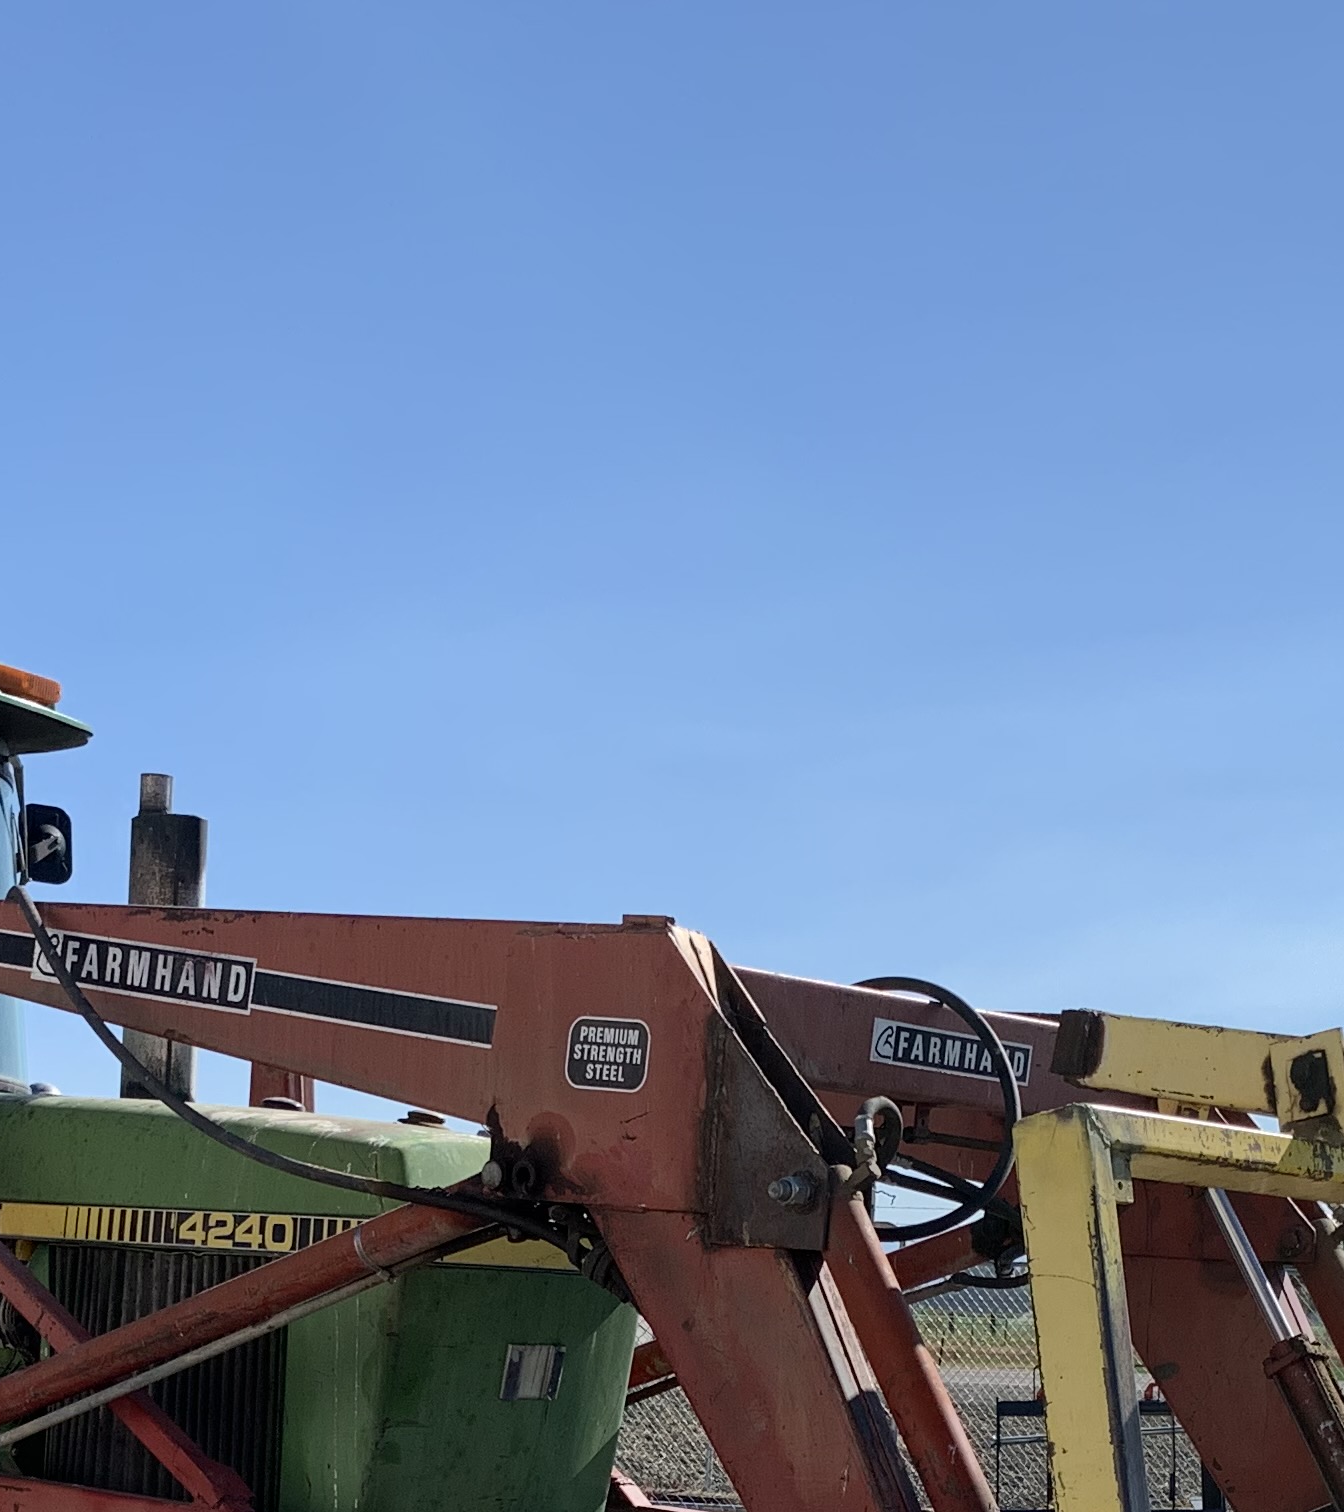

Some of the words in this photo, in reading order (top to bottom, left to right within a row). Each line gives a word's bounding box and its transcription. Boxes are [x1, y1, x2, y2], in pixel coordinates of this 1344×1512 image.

[65, 940, 247, 1003] FARMHAND
[579, 1026, 640, 1046] PREMIUM
[573, 1044, 642, 1065] STRENGTH
[897, 1031, 1025, 1078] FARMHAD
[585, 1063, 625, 1082] STEEL
[179, 1210, 294, 1252] 4240
